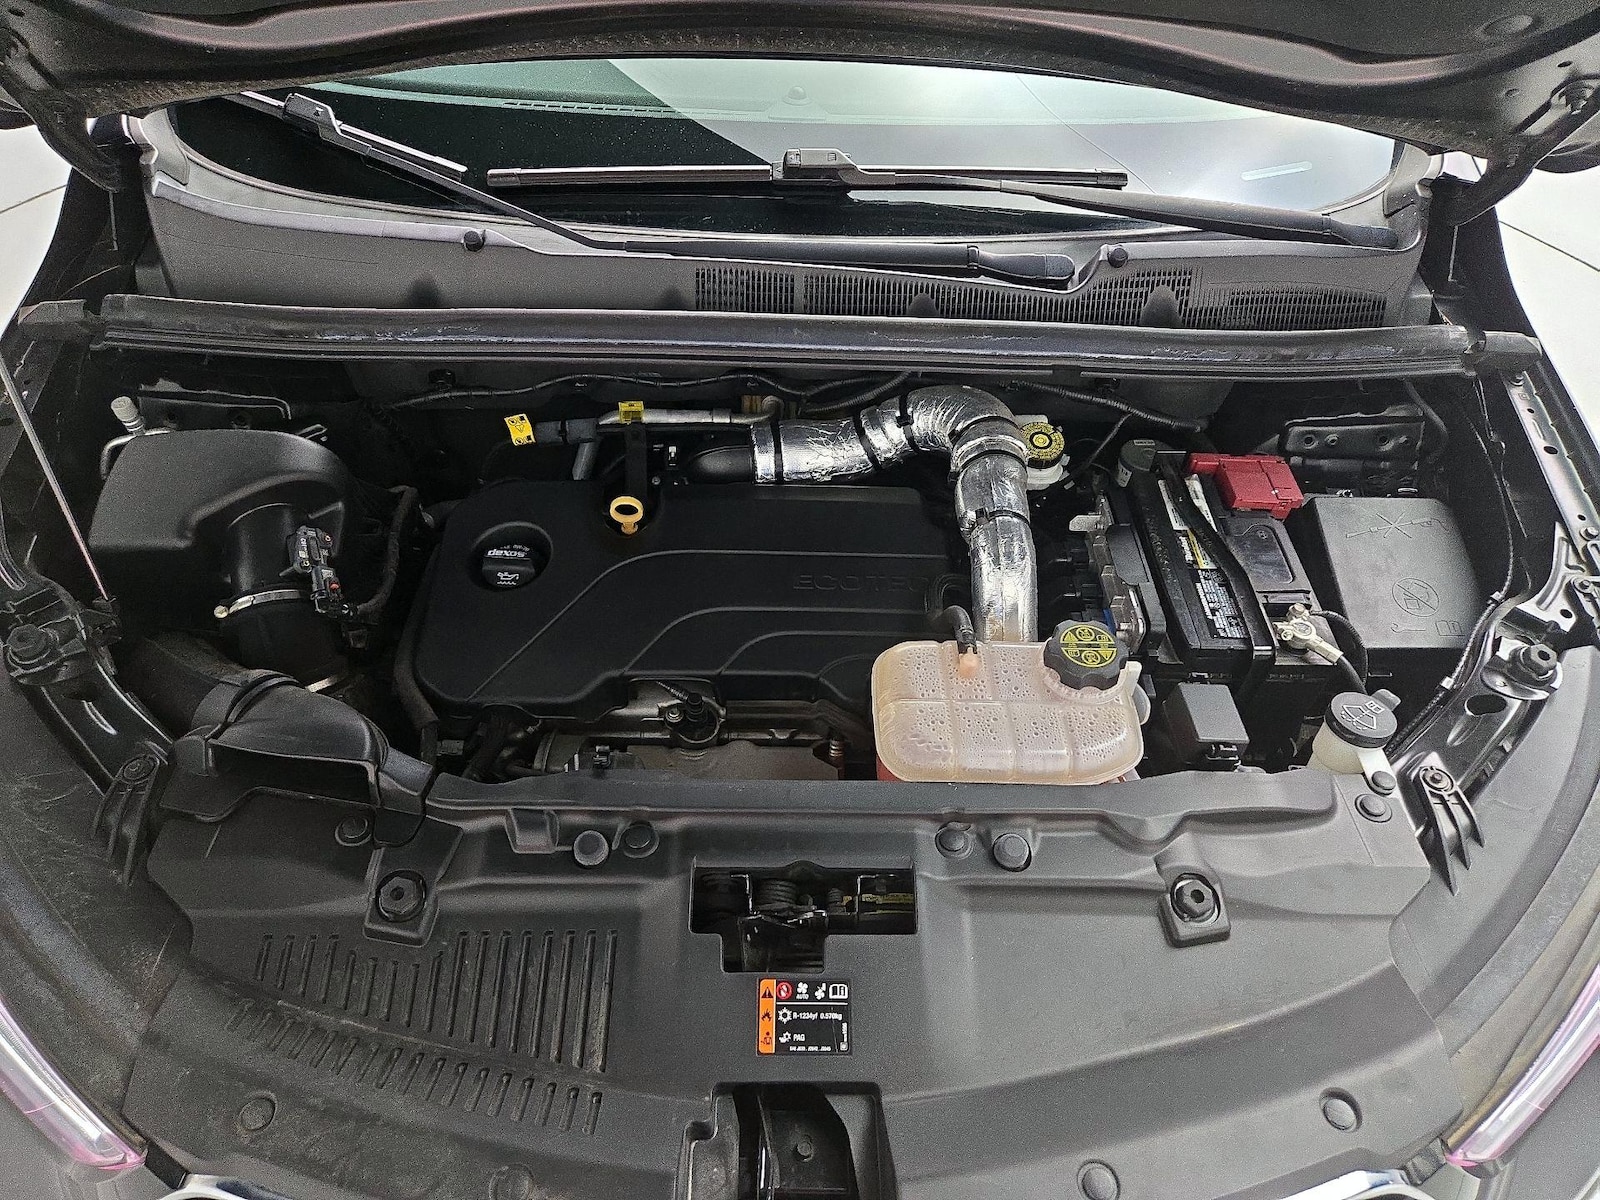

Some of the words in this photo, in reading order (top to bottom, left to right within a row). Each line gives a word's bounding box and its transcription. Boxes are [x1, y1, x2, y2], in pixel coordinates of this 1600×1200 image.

[487, 549, 525, 558] dexos
[793, 575, 929, 591] ECOTEC
[792, 1012, 818, 1020] R-1234yf
[820, 1012, 843, 1020] 0.570kg
